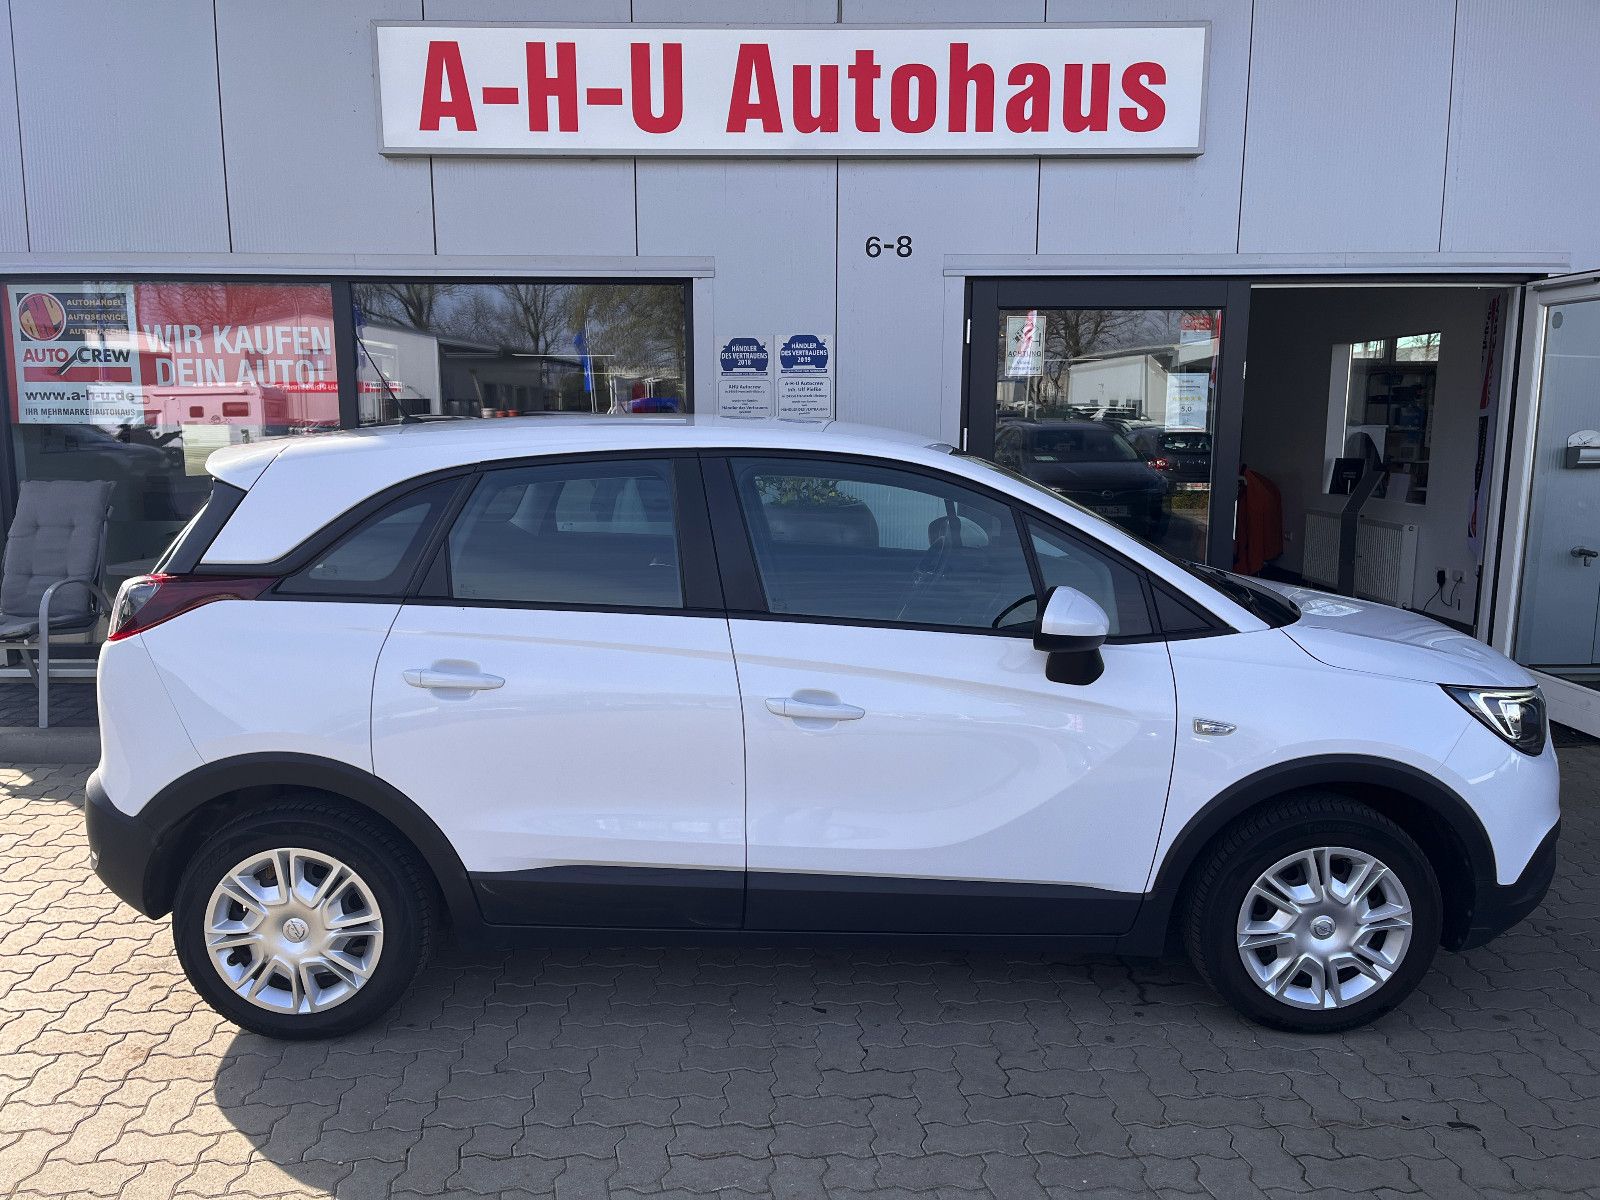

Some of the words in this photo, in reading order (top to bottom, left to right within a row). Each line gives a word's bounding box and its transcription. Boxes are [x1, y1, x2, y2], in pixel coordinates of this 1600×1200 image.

[419, 41, 683, 134] A-H-U
[726, 42, 1167, 133] Autohaus
[865, 235, 913, 258] 6-8
[67, 313, 127, 321] AUTOSERVICE
[143, 324, 204, 353] WIR
[213, 325, 332, 355] KAUFEN
[791, 341, 817, 349] HÄNDLER
[731, 344, 758, 352] HÄNDLER
[23, 348, 69, 363] AUTO
[77, 347, 130, 363] CREW
[721, 352, 732, 360] DES
[732, 352, 768, 360] VERTRAUENS
[155, 358, 226, 387] DEIN
[237, 358, 324, 388] AUTO!
[25, 388, 135, 401] www.a-h-u.de
[25, 407, 39, 416] IHR
[40, 407, 136, 417] MEHRMARKENAUTOHAUS
